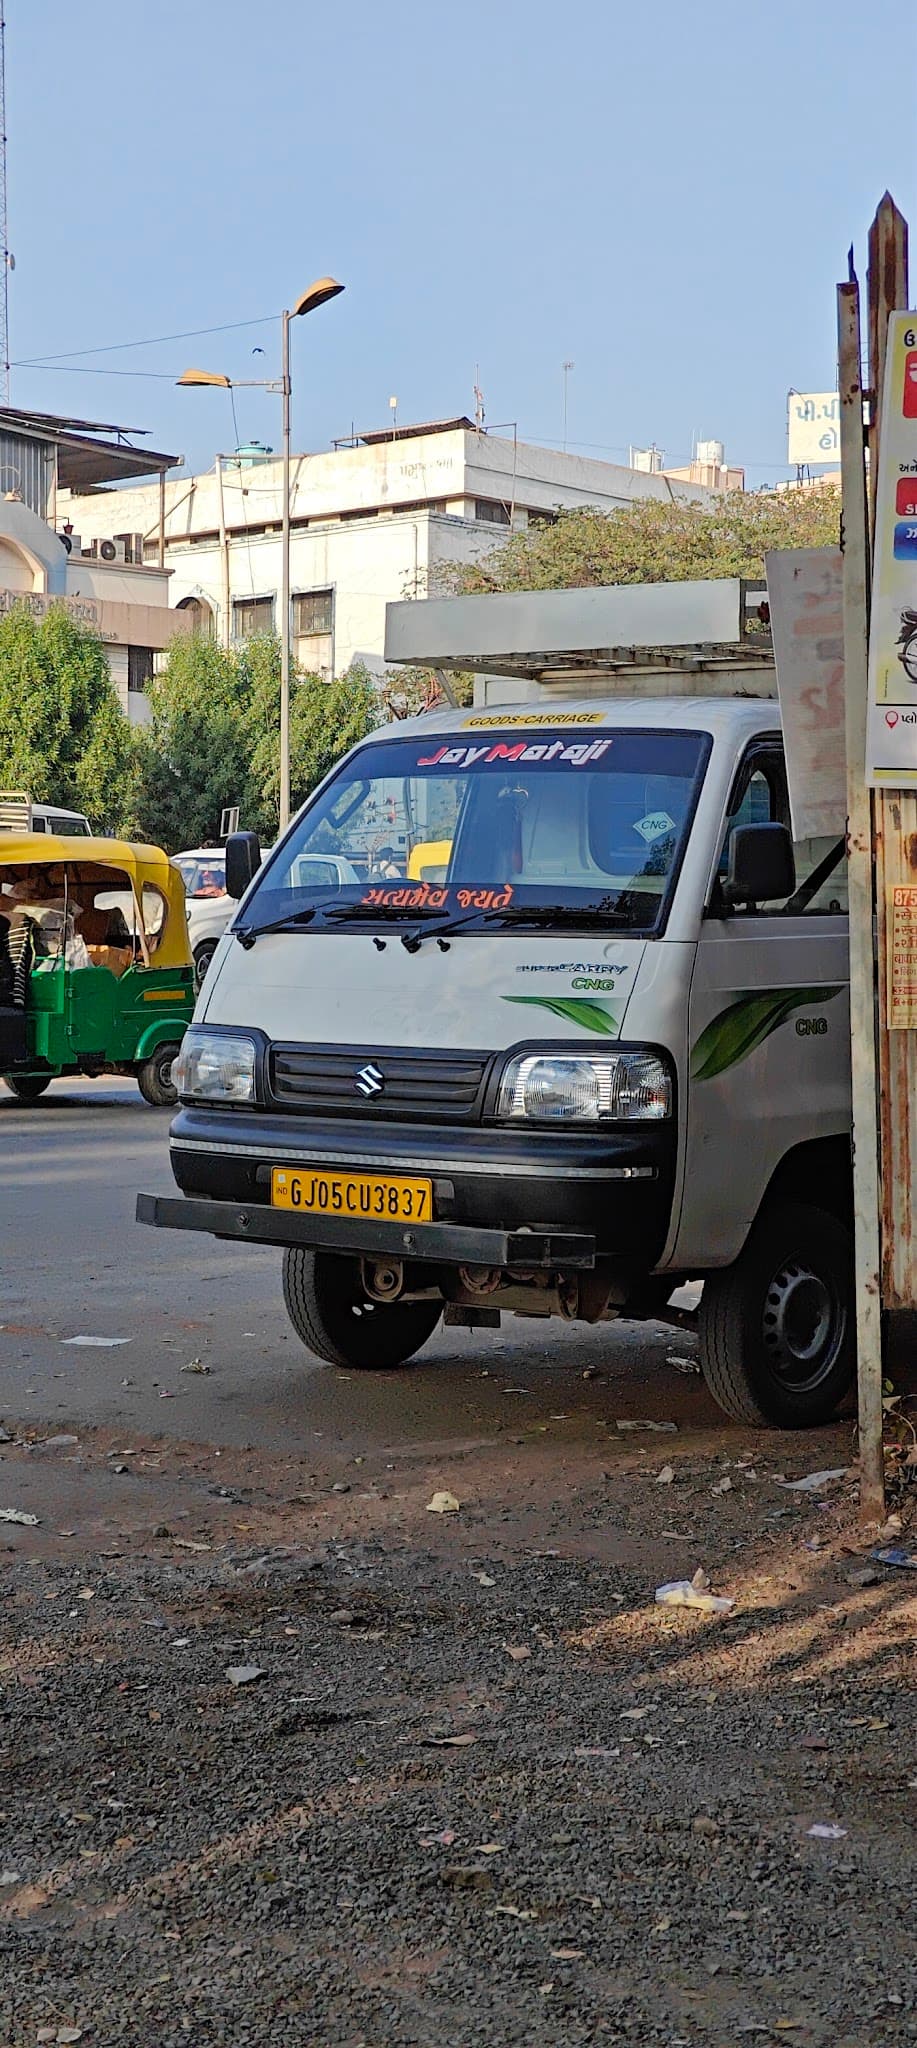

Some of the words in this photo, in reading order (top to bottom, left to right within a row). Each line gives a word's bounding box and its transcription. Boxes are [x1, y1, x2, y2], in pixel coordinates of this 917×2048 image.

[469, 713, 598, 726] GOODS-CARRIAGE
[417, 746, 492, 768] Jay
[484, 740, 613, 765] Mataji
[641, 820, 668, 830] CNG
[558, 963, 629, 975] CARRY
[572, 977, 615, 991] CNG
[795, 1018, 828, 1036] CNG
[291, 1178, 427, 1218] GJ05CU3837
